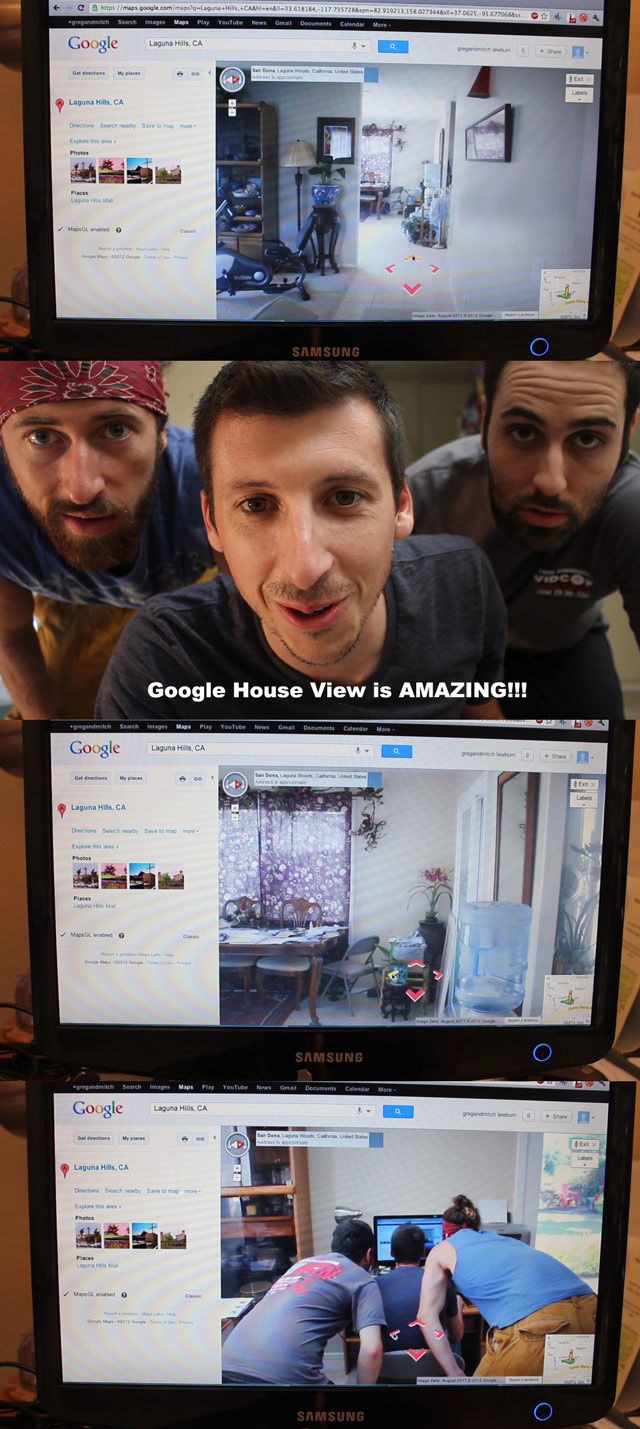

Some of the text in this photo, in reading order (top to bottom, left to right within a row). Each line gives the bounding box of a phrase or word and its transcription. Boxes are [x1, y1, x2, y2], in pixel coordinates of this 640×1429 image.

[68, 35, 119, 54] Google
[149, 40, 173, 48] Laguna
[69, 99, 94, 107] Laguna
[292, 346, 360, 358] SAMSUNG
[70, 740, 120, 759] Google
[151, 744, 176, 752] Laguna
[71, 804, 96, 812] Laguna
[295, 1051, 363, 1063] SAMSUNG
[72, 1100, 123, 1119] Google
[153, 1104, 178, 1112] Laguna
[74, 1164, 99, 1172] Laguna
[297, 1411, 365, 1422] SAMSUNG
